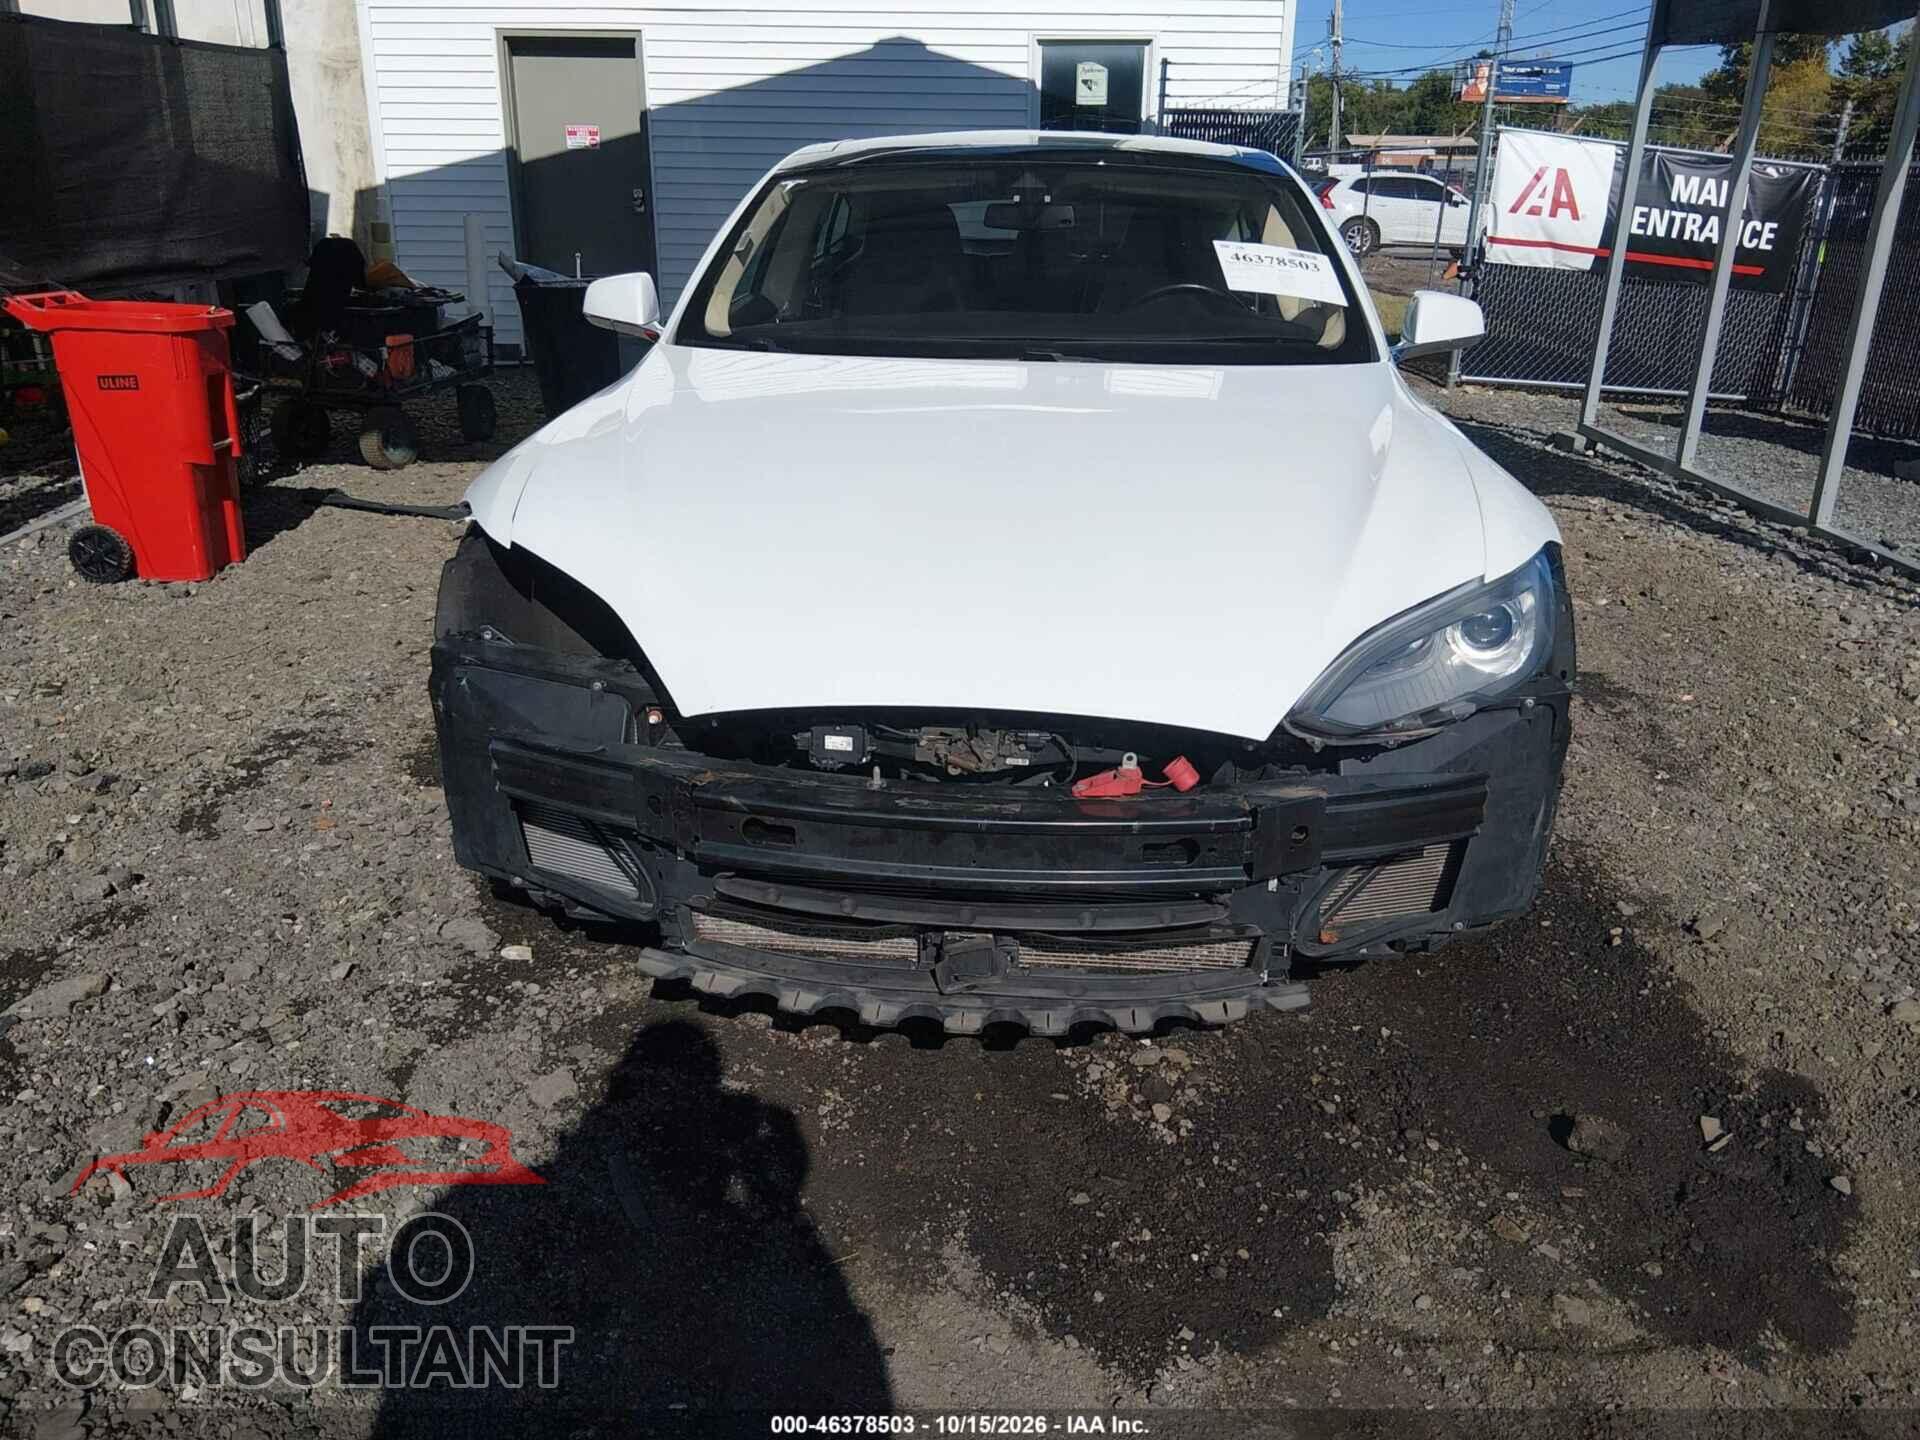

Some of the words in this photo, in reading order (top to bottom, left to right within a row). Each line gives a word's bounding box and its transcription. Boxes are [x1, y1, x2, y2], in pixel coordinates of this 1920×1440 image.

[1670, 173, 1749, 210] MAI
[1230, 252, 1320, 273] 46378503
[100, 377, 137, 389] ULINE
